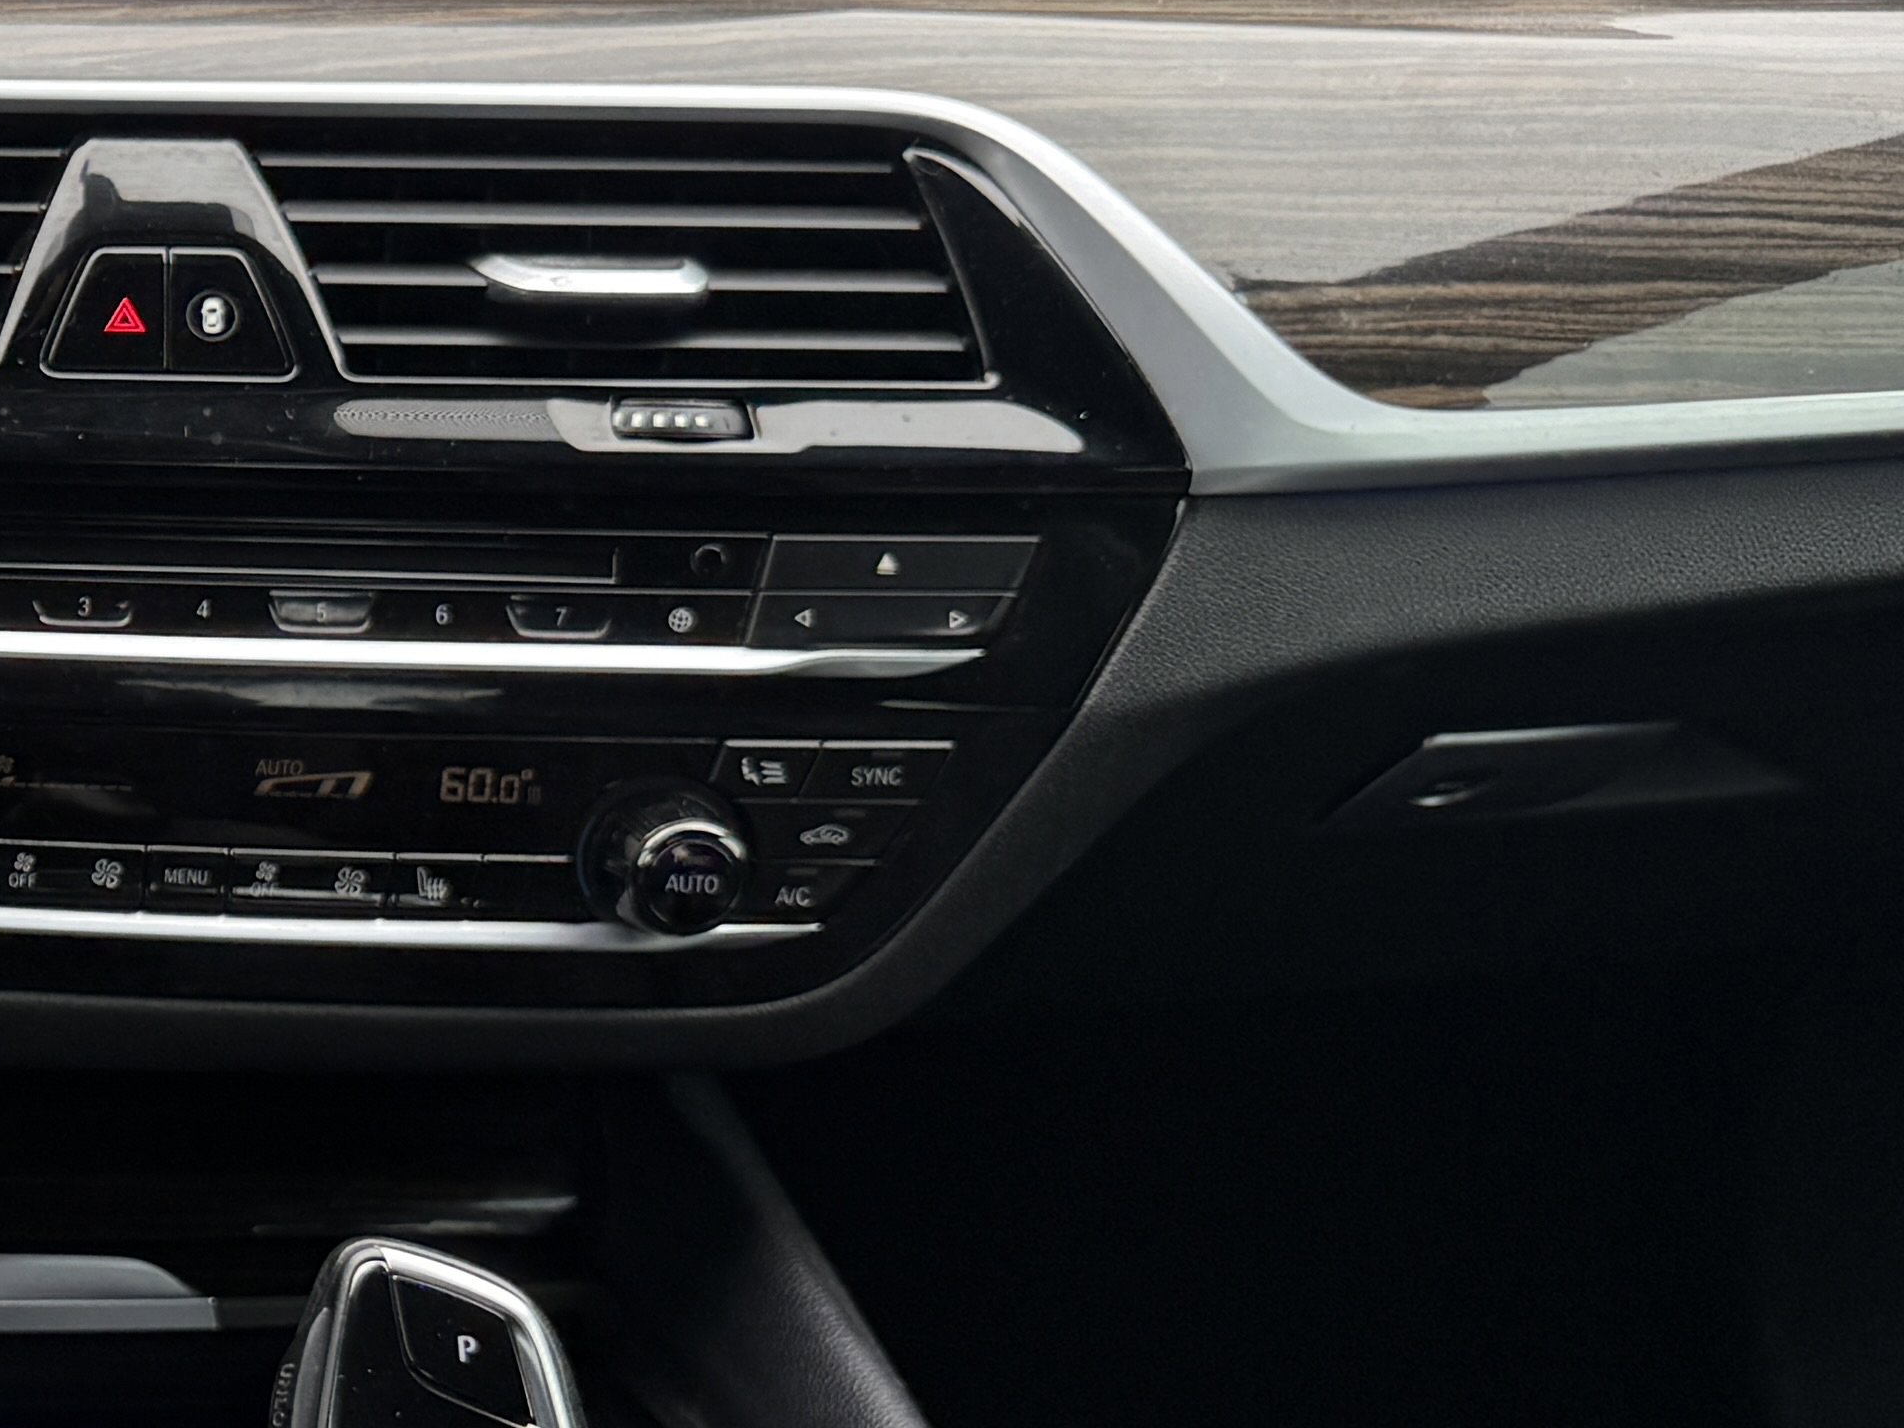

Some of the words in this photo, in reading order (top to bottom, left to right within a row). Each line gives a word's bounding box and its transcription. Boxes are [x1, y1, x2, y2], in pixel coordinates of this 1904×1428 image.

[78, 595, 93, 617] 3
[196, 598, 212, 619] 4
[314, 602, 329, 623] 5
[435, 604, 451, 626] 6
[554, 606, 570, 627] 7
[255, 759, 304, 776] AUTO
[850, 766, 903, 787] SYNC
[8, 874, 37, 888] OFF
[164, 869, 210, 886] MENU
[665, 874, 720, 895] AUTO
[249, 882, 279, 897] OFF
[774, 886, 813, 908] A/C
[457, 1335, 480, 1363] P
